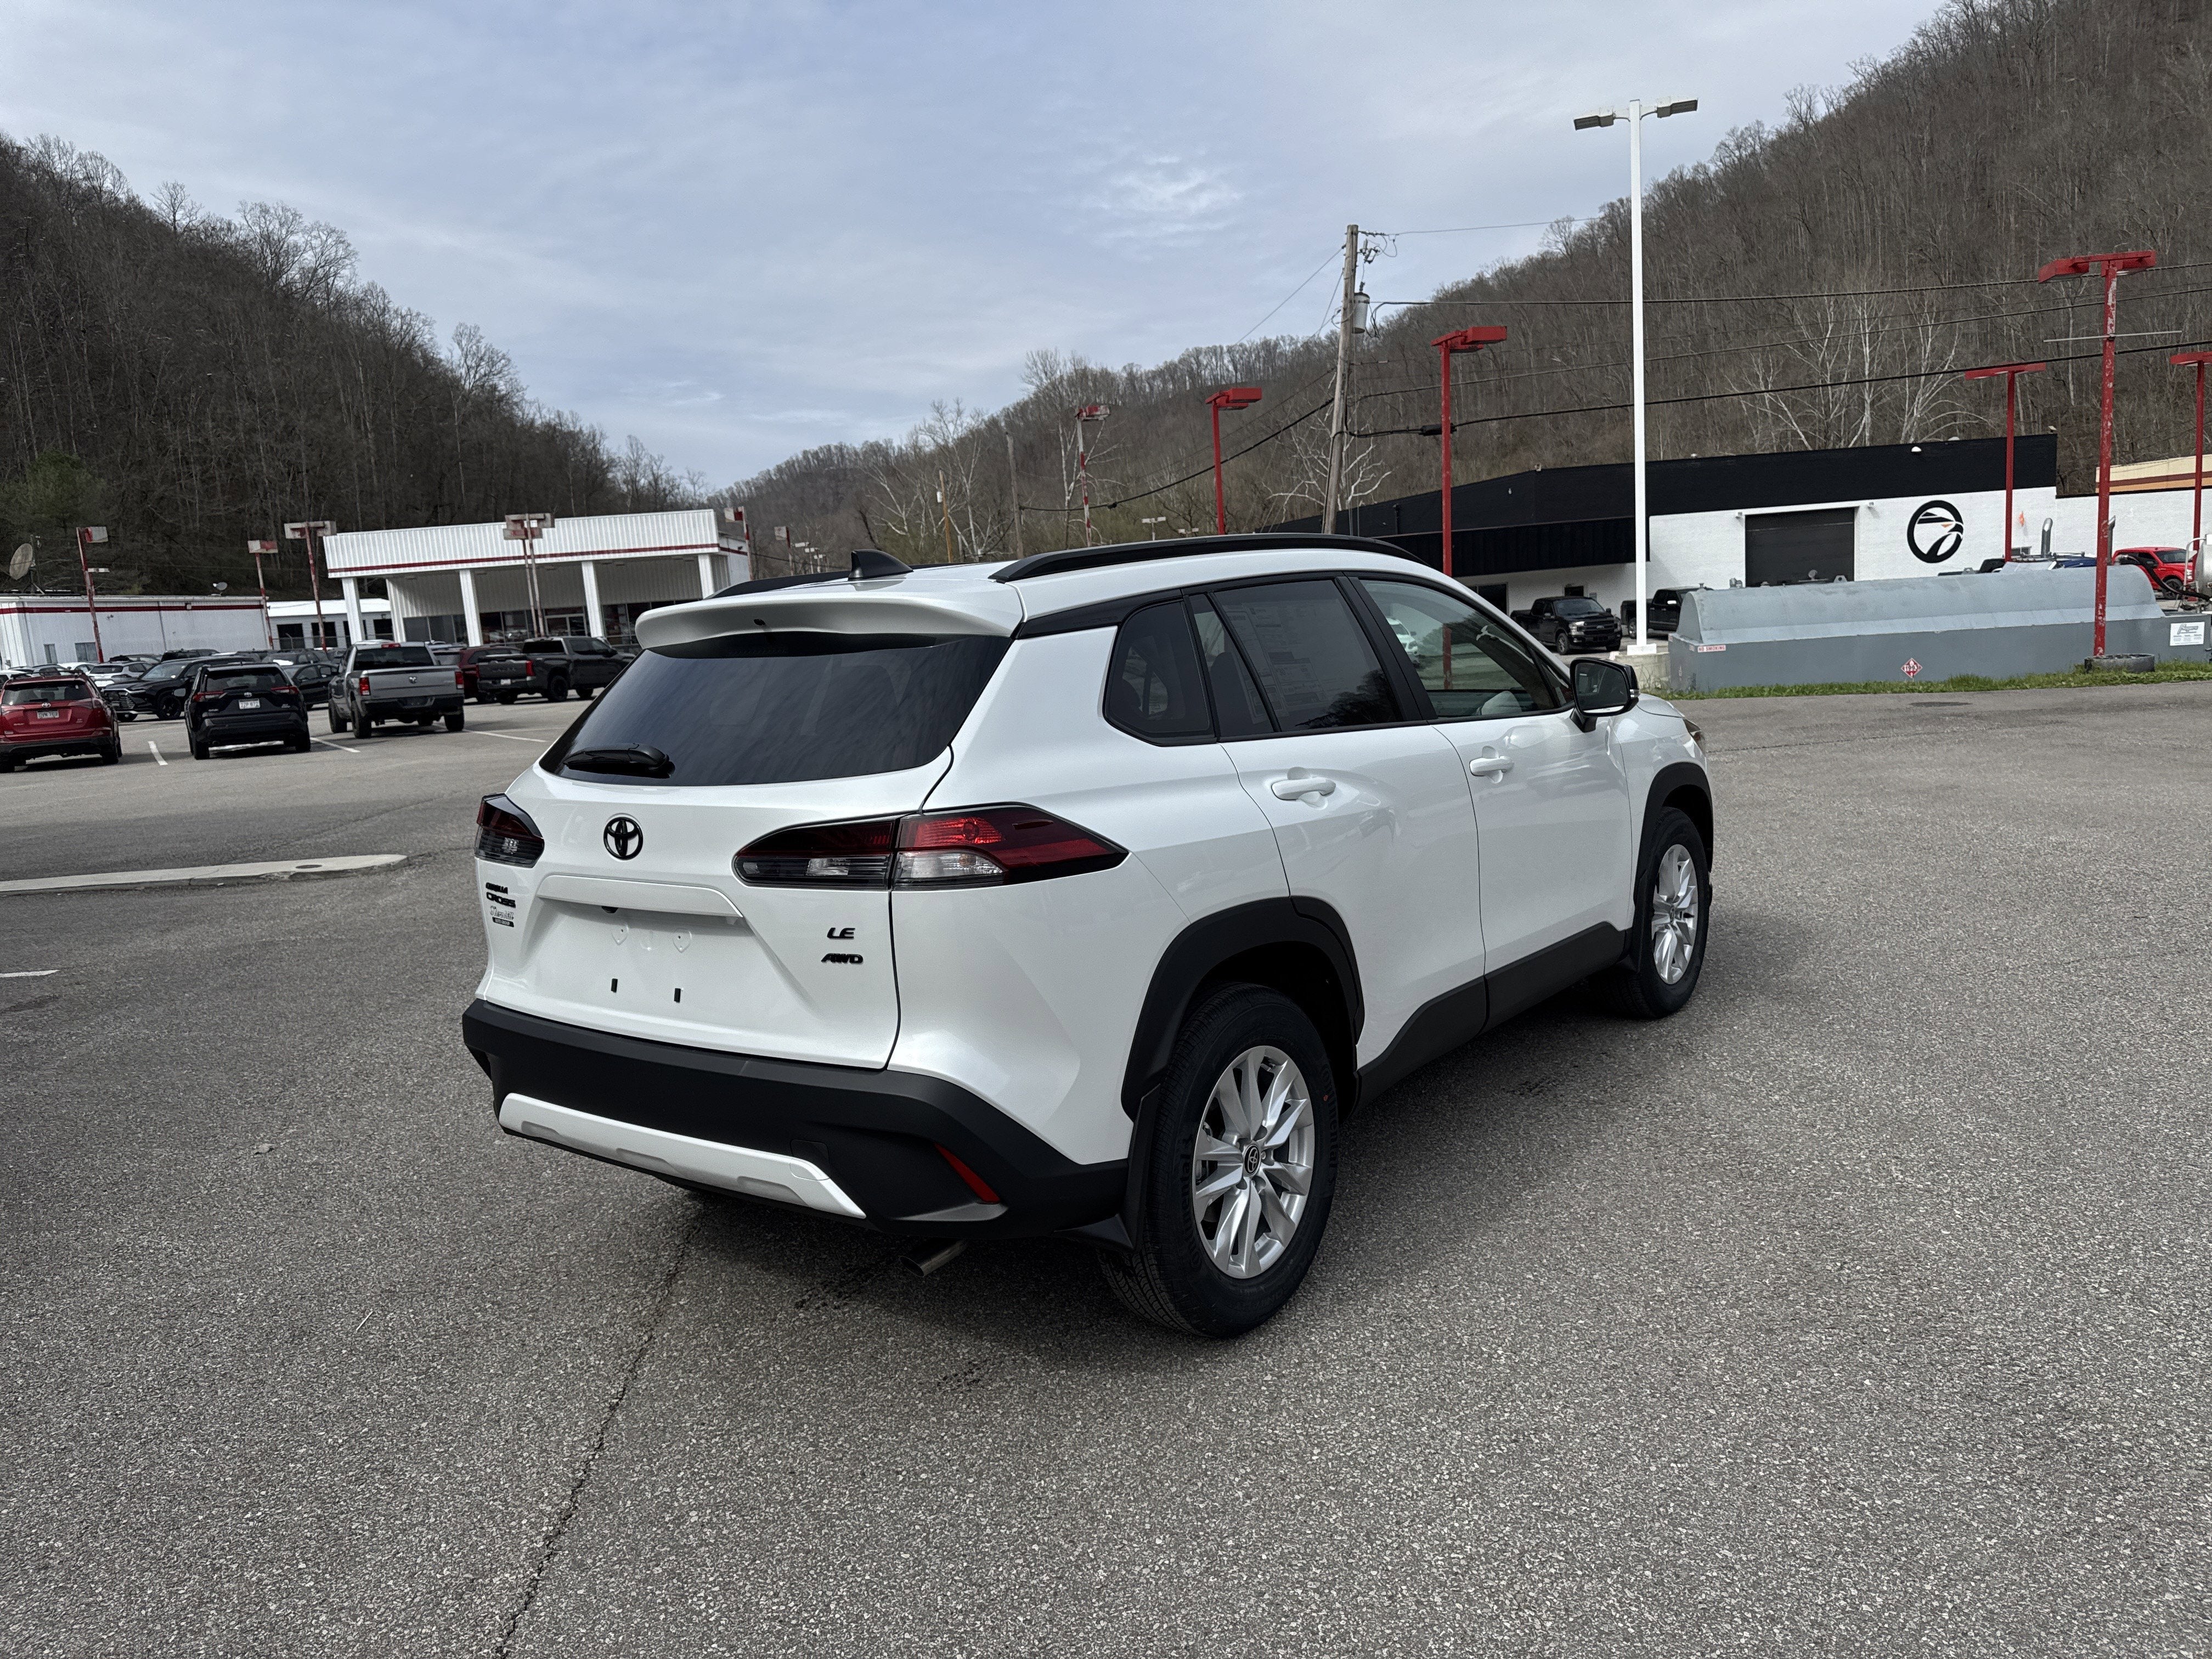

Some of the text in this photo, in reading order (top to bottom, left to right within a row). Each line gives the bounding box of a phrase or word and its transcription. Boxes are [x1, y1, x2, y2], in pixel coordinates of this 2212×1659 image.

[487, 892, 516, 909] CROSS
[827, 927, 855, 939] LE
[821, 953, 863, 963] AWD
